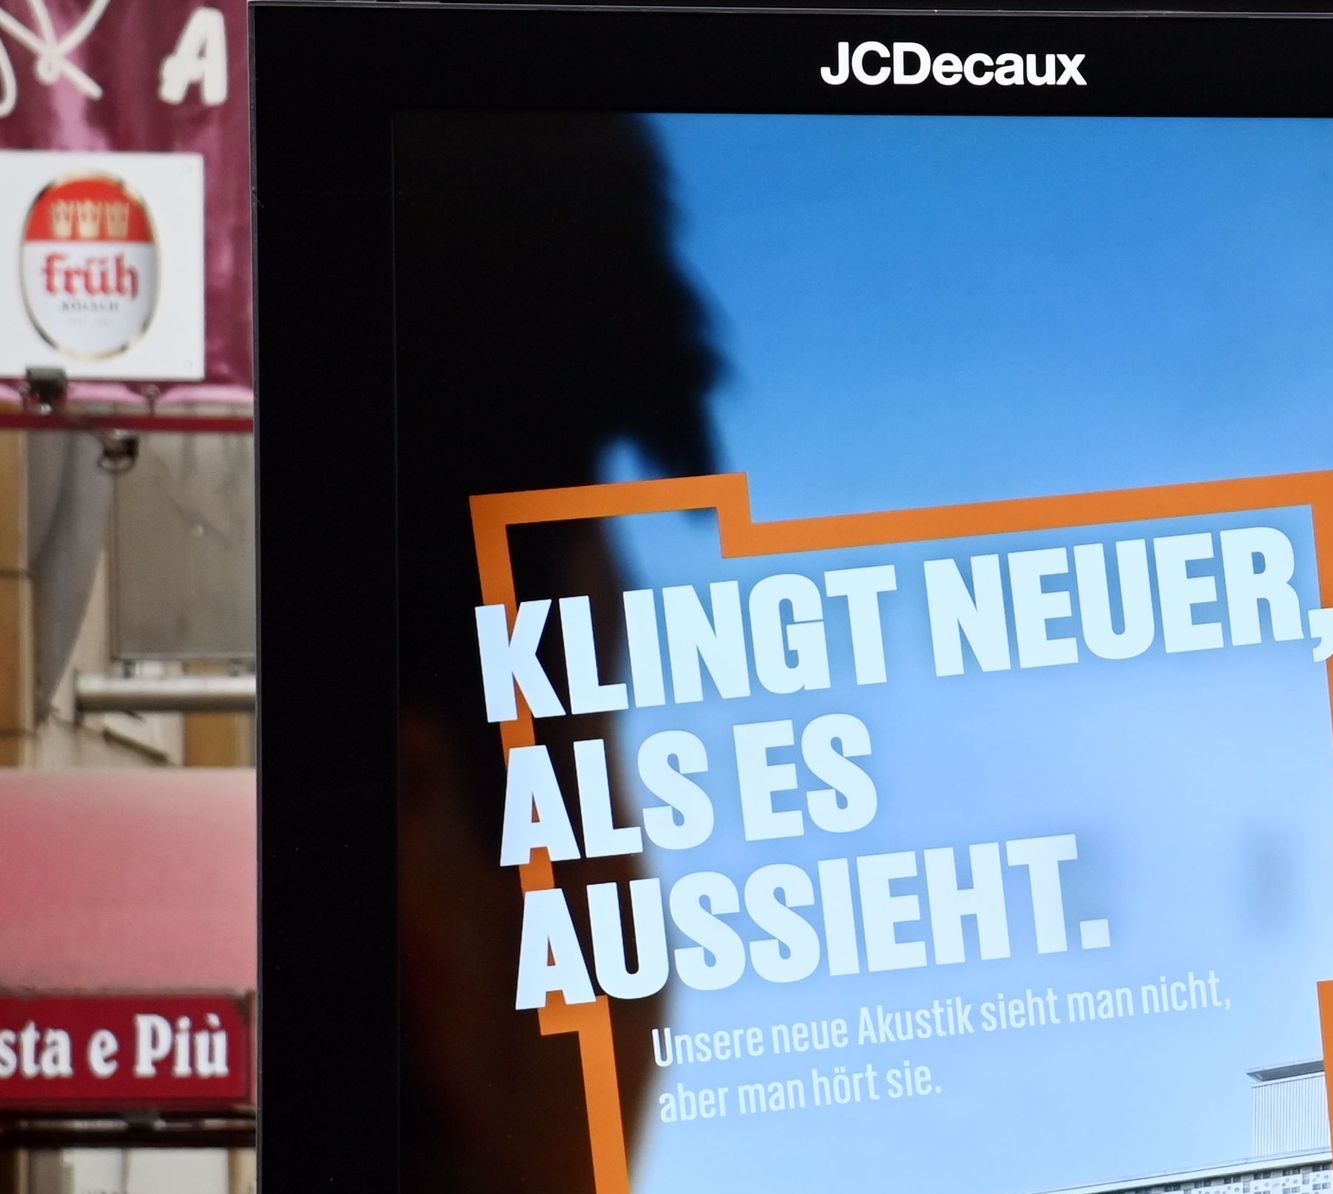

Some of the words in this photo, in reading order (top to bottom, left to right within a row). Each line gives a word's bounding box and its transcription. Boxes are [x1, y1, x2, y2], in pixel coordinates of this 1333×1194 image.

[820, 41, 1088, 86] JCDecaux
[43, 252, 139, 301] früh
[474, 564, 897, 724] KLINGT
[499, 728, 714, 868] ALS
[733, 713, 878, 842] ES
[515, 834, 1111, 1011] AUSSIEHT.
[87, 1028, 119, 1078] e
[134, 1012, 229, 1078] Più
[652, 1027, 764, 1068] Unsere
[771, 1017, 850, 1056] neue
[857, 1002, 974, 1046] Akustik
[980, 989, 1059, 1032] sieht
[1067, 984, 1135, 1024] man
[1141, 969, 1232, 1015] nicht,
[659, 1079, 729, 1123] aber
[737, 1076, 804, 1115] man
[811, 1064, 880, 1107] hört
[886, 1060, 942, 1099] sie.
